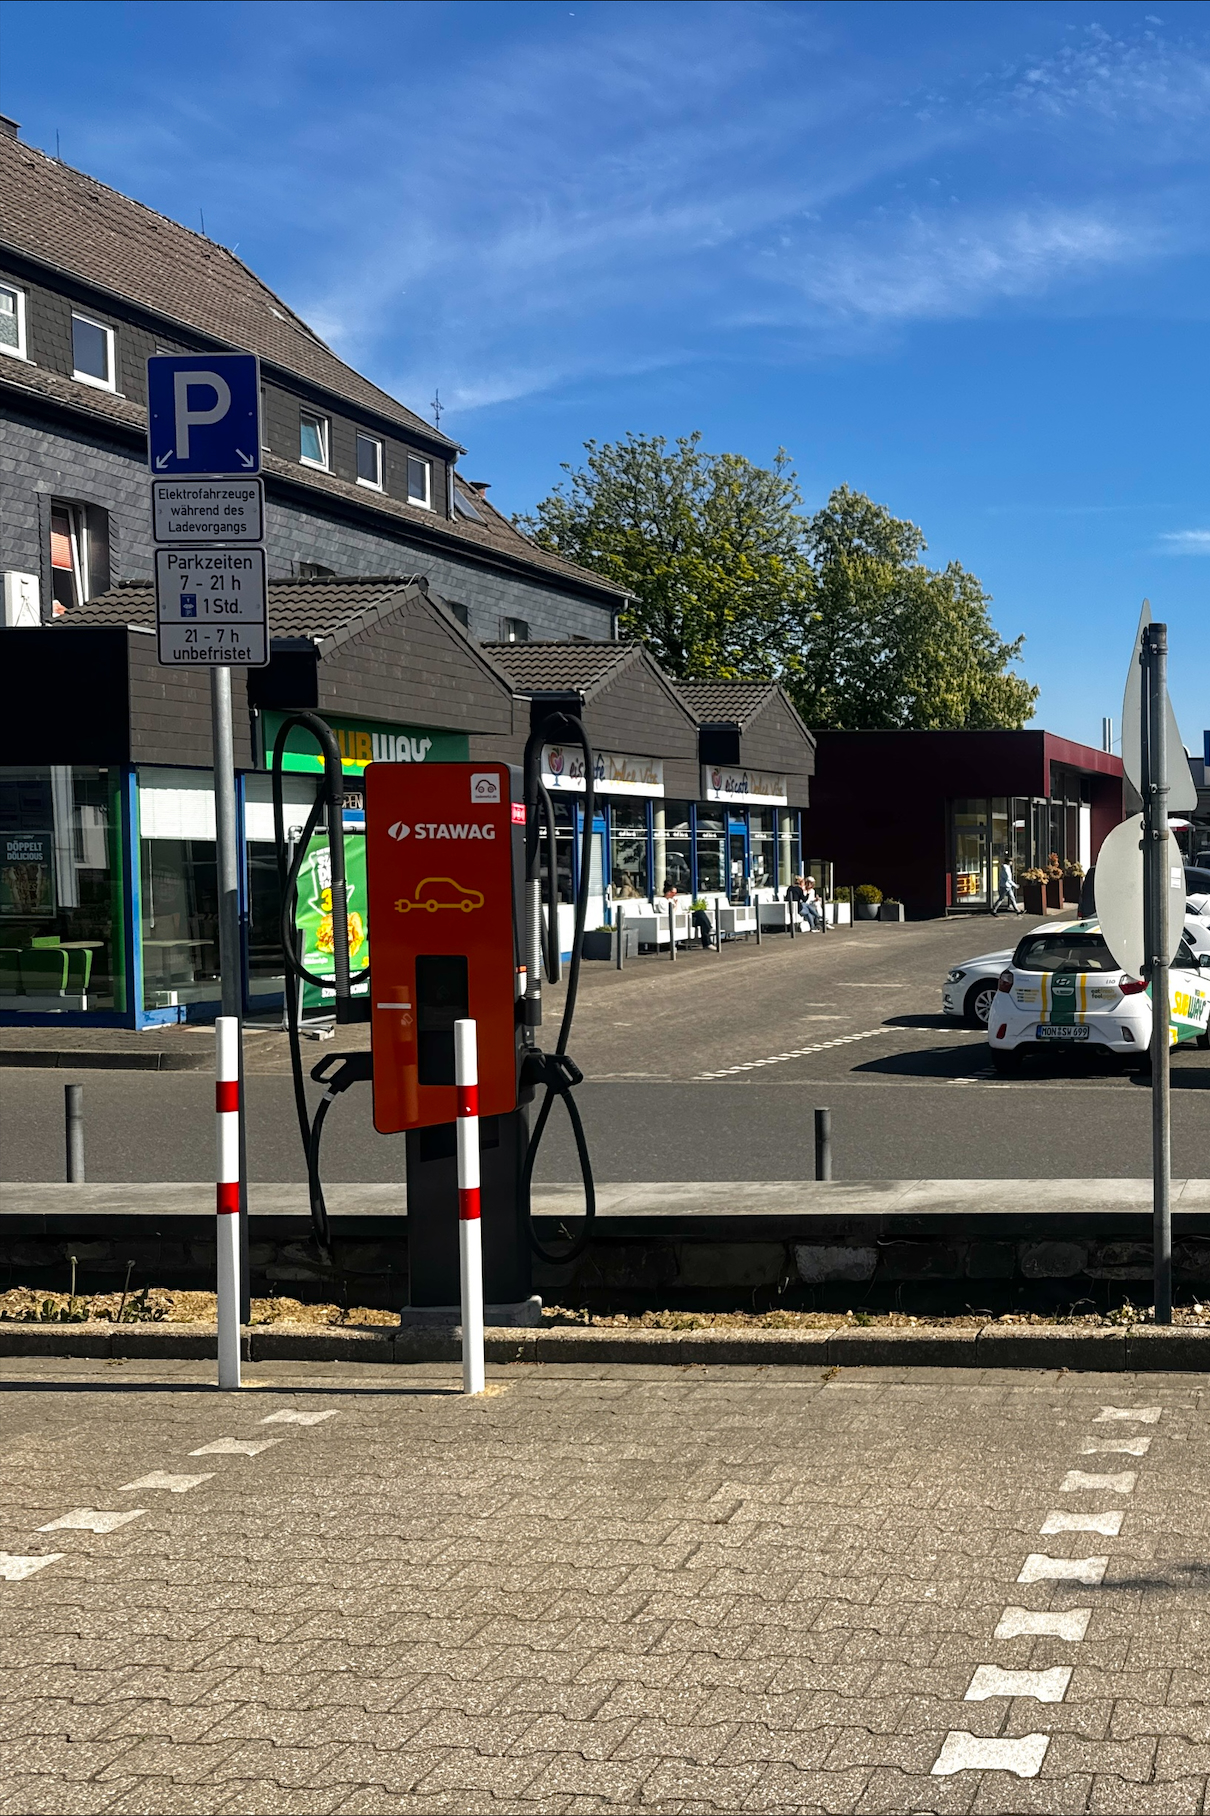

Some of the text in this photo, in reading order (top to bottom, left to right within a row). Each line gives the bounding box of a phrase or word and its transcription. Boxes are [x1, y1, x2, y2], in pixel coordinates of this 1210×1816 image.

[174, 371, 231, 459] P
[158, 488, 256, 502] Elektrofahrzeuge
[171, 504, 244, 516] während des
[168, 522, 247, 534] Ladevorgangs
[168, 554, 253, 570] Parkzeiten
[180, 576, 189, 591] 7
[210, 575, 224, 590] 21
[232, 575, 241, 590] h
[185, 629, 198, 643] 21
[217, 629, 225, 643] 7
[231, 629, 239, 643] h
[174, 646, 251, 660] unbefristet
[415, 824, 496, 840] STAWAG
[1042, 1028, 1057, 1036] MON
[1073, 1028, 1087, 1036] 699
